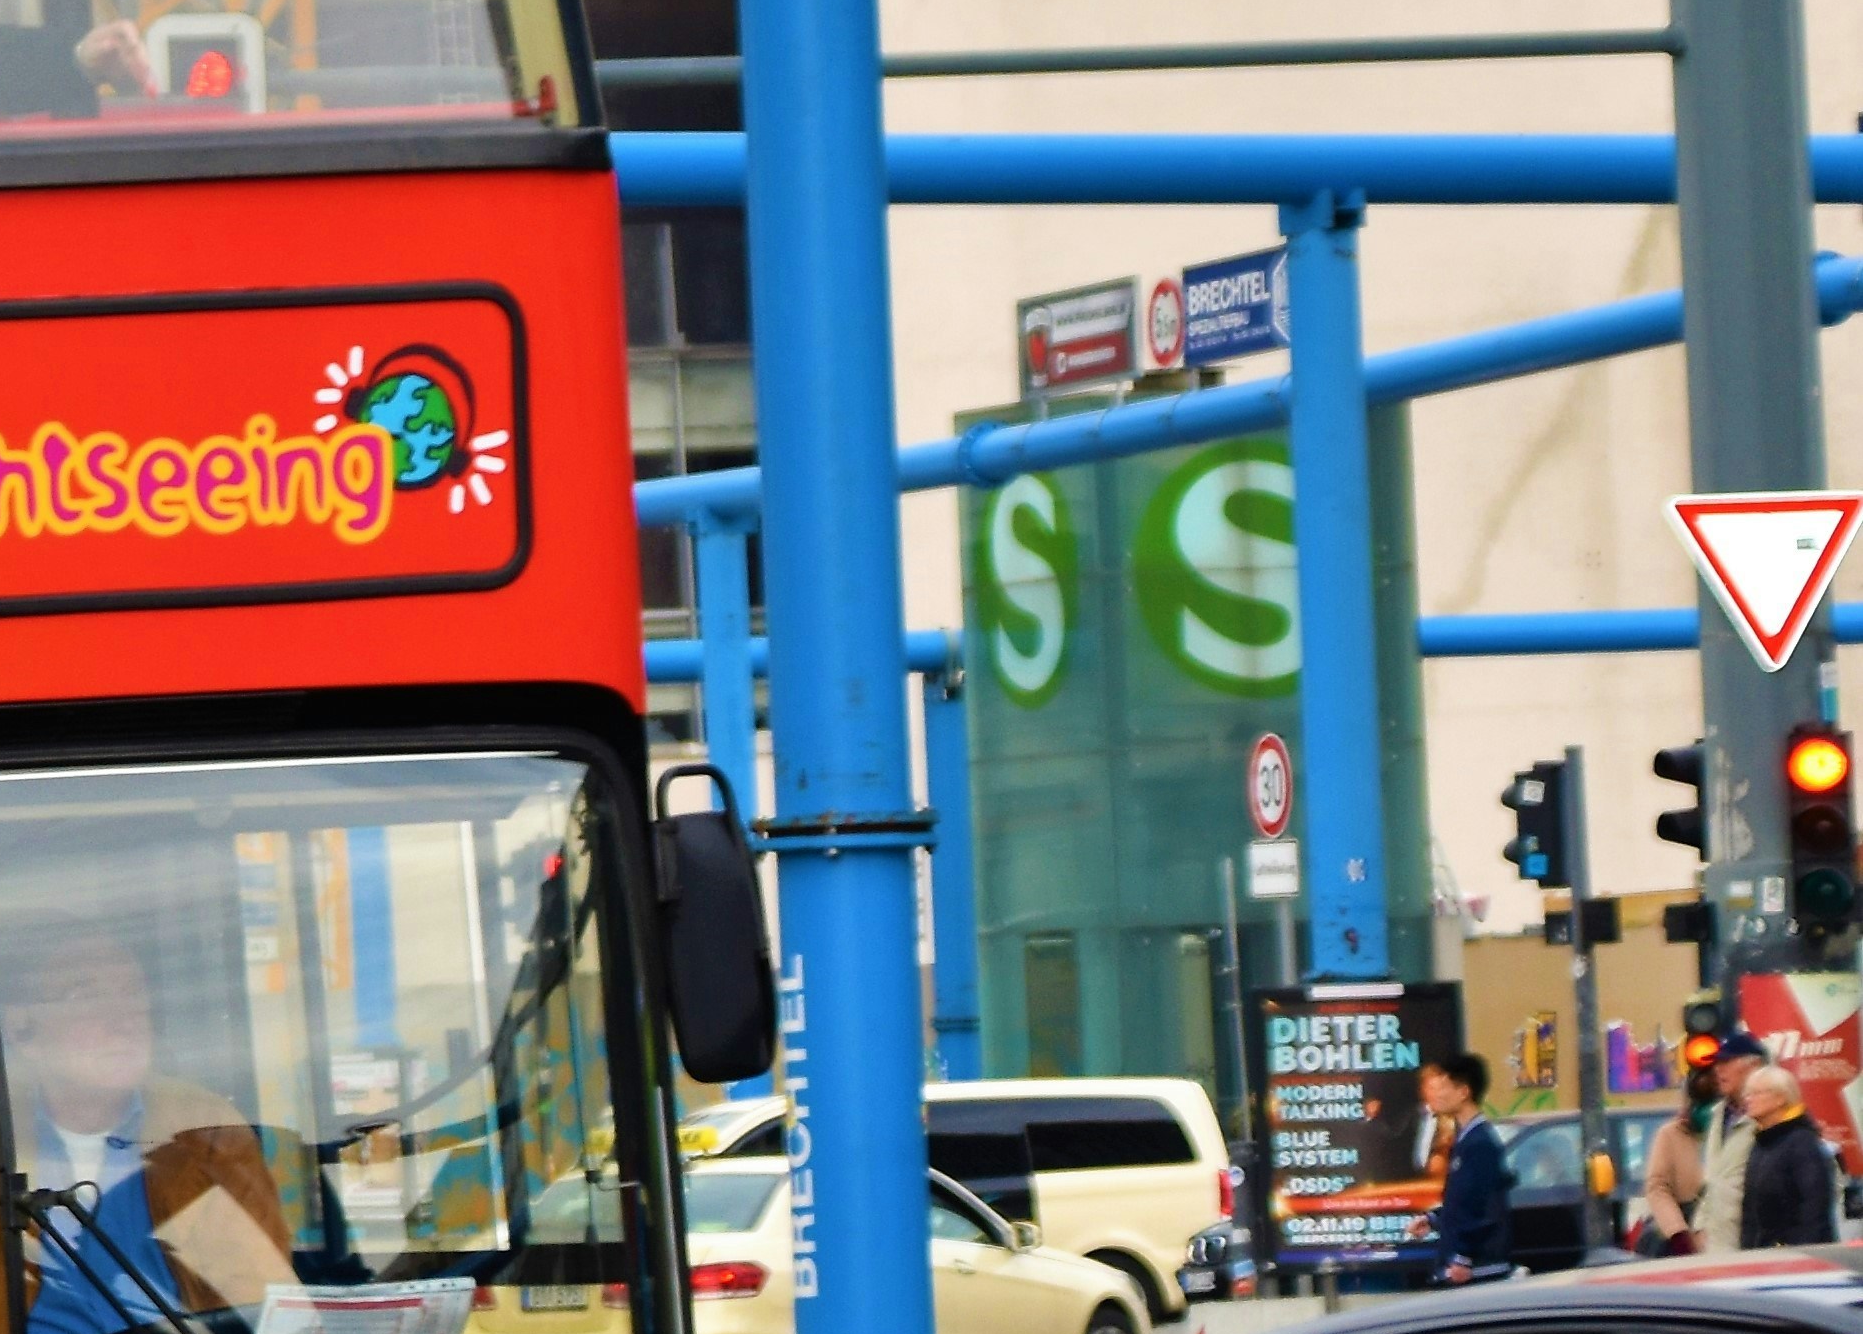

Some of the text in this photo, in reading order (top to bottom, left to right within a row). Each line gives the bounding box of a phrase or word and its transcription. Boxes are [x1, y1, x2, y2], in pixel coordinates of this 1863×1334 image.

[1188, 270, 1271, 316] BRECHTEL
[988, 471, 1065, 692] S
[1259, 762, 1284, 809] 30
[1270, 1014, 1402, 1044] DIETER
[1270, 1041, 1420, 1073] BOHLEN
[1275, 1083, 1364, 1102] MODERN
[778, 953, 819, 1298] BRECHTEL
[1279, 1102, 1364, 1121] TALKING
[1275, 1130, 1331, 1149] BLUE
[1276, 1149, 1359, 1167] SYSTEM
